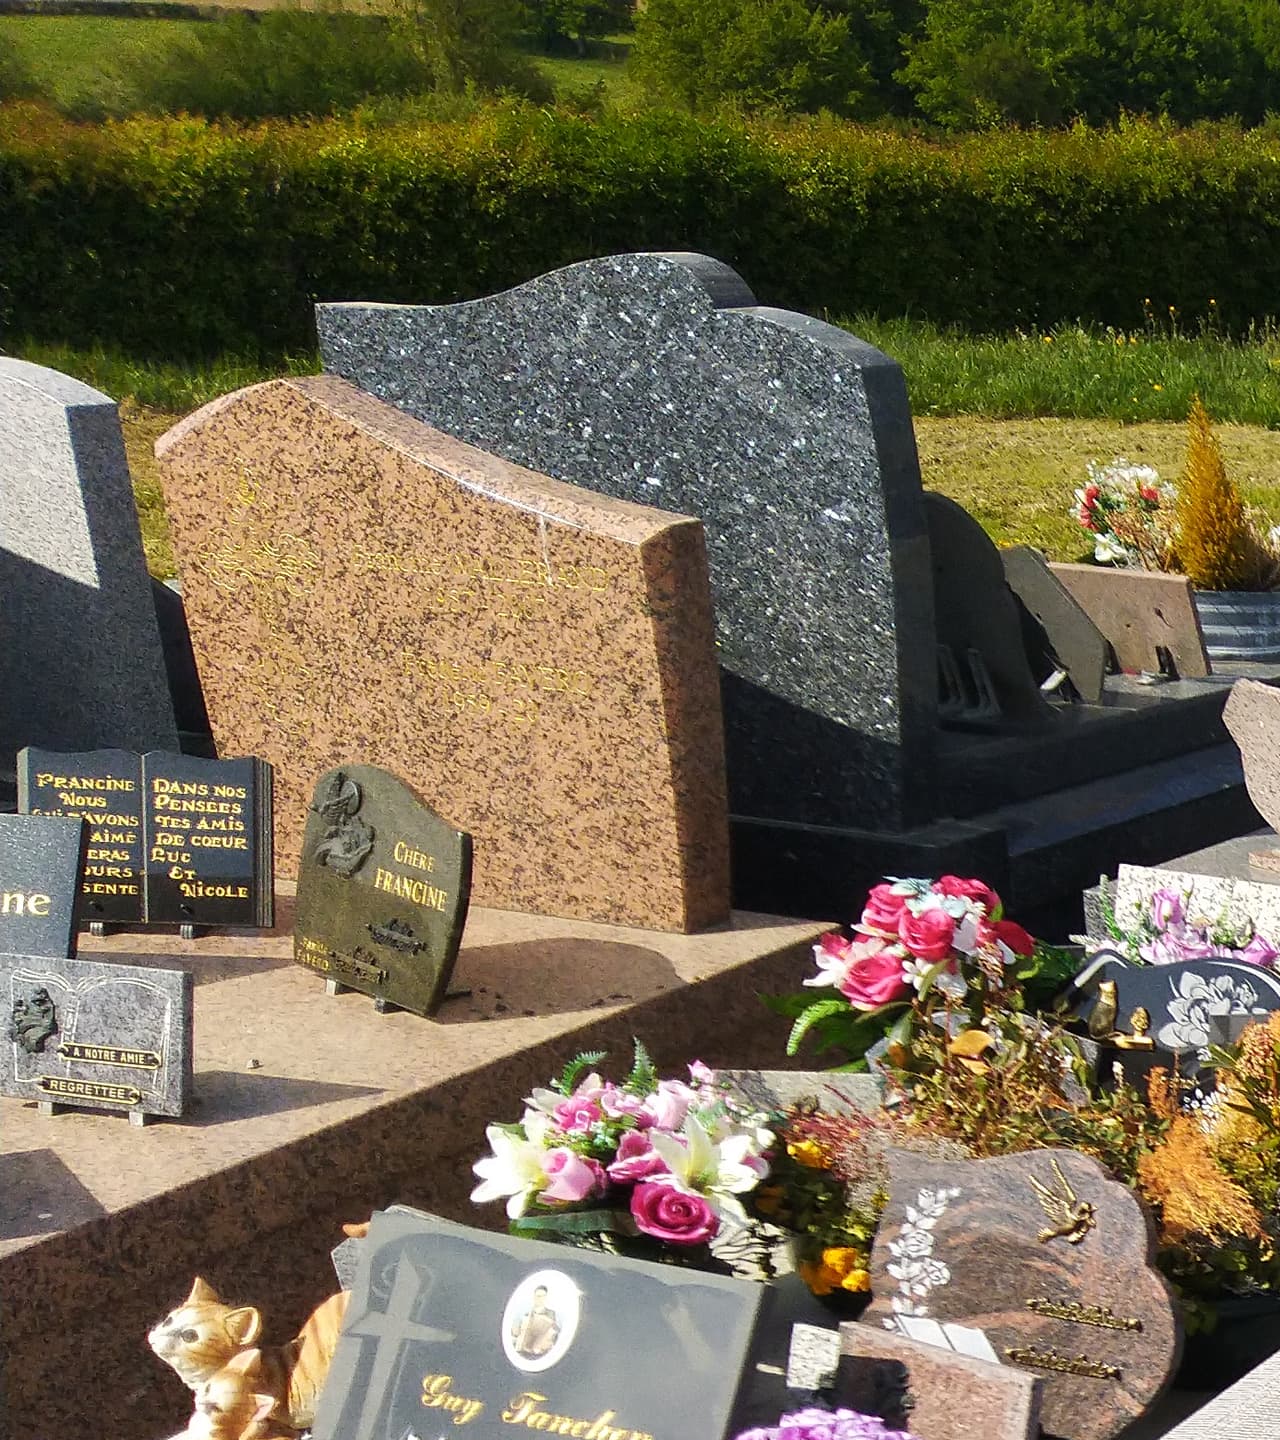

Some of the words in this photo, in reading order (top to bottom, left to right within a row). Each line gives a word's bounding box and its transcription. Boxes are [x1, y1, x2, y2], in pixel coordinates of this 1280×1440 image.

[152, 778, 209, 796] DANS
[213, 784, 247, 799] NOS
[155, 815, 192, 829] TES
[197, 816, 246, 831] AMIS
[155, 832, 186, 847] DE
[151, 848, 192, 863] LUC
[168, 865, 197, 880] ET
[178, 880, 249, 899] NICOLE
[374, 868, 448, 912] FRANCINE
[73, 1049, 81, 1058] A
[84, 1050, 117, 1062] NOTRE
[120, 1053, 146, 1065] AMIE
[49, 1079, 126, 1099] REGRETTEE
[421, 1374, 485, 1425] Guy
